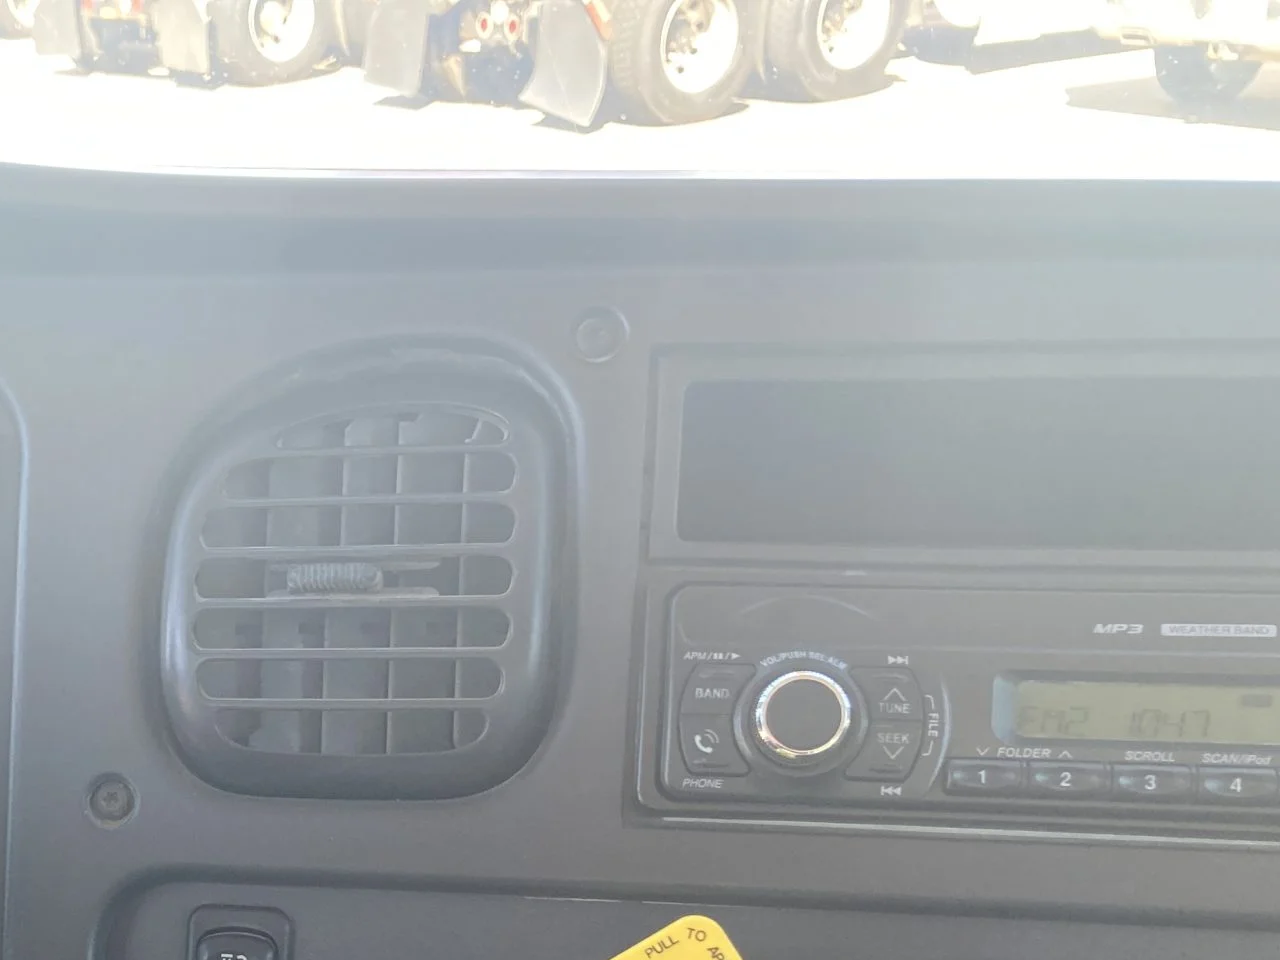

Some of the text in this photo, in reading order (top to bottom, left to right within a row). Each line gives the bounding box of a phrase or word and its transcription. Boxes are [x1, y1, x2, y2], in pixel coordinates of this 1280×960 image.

[1092, 623, 1144, 635] MP3
[1169, 625, 1270, 636] WEATHER BAND
[695, 688, 731, 699] BAND
[878, 703, 911, 714] TUNE
[928, 713, 939, 738] FILE
[877, 733, 910, 744] SEEK
[997, 747, 1051, 759] FOLDER
[1124, 750, 1176, 763] SCROLL
[978, 770, 987, 784] 1
[1059, 772, 1072, 787] 2
[1144, 775, 1157, 790] 3
[682, 779, 724, 789] PHONE
[1229, 777, 1243, 793] 4
[644, 935, 680, 960] PULL
[686, 927, 708, 943] TO
